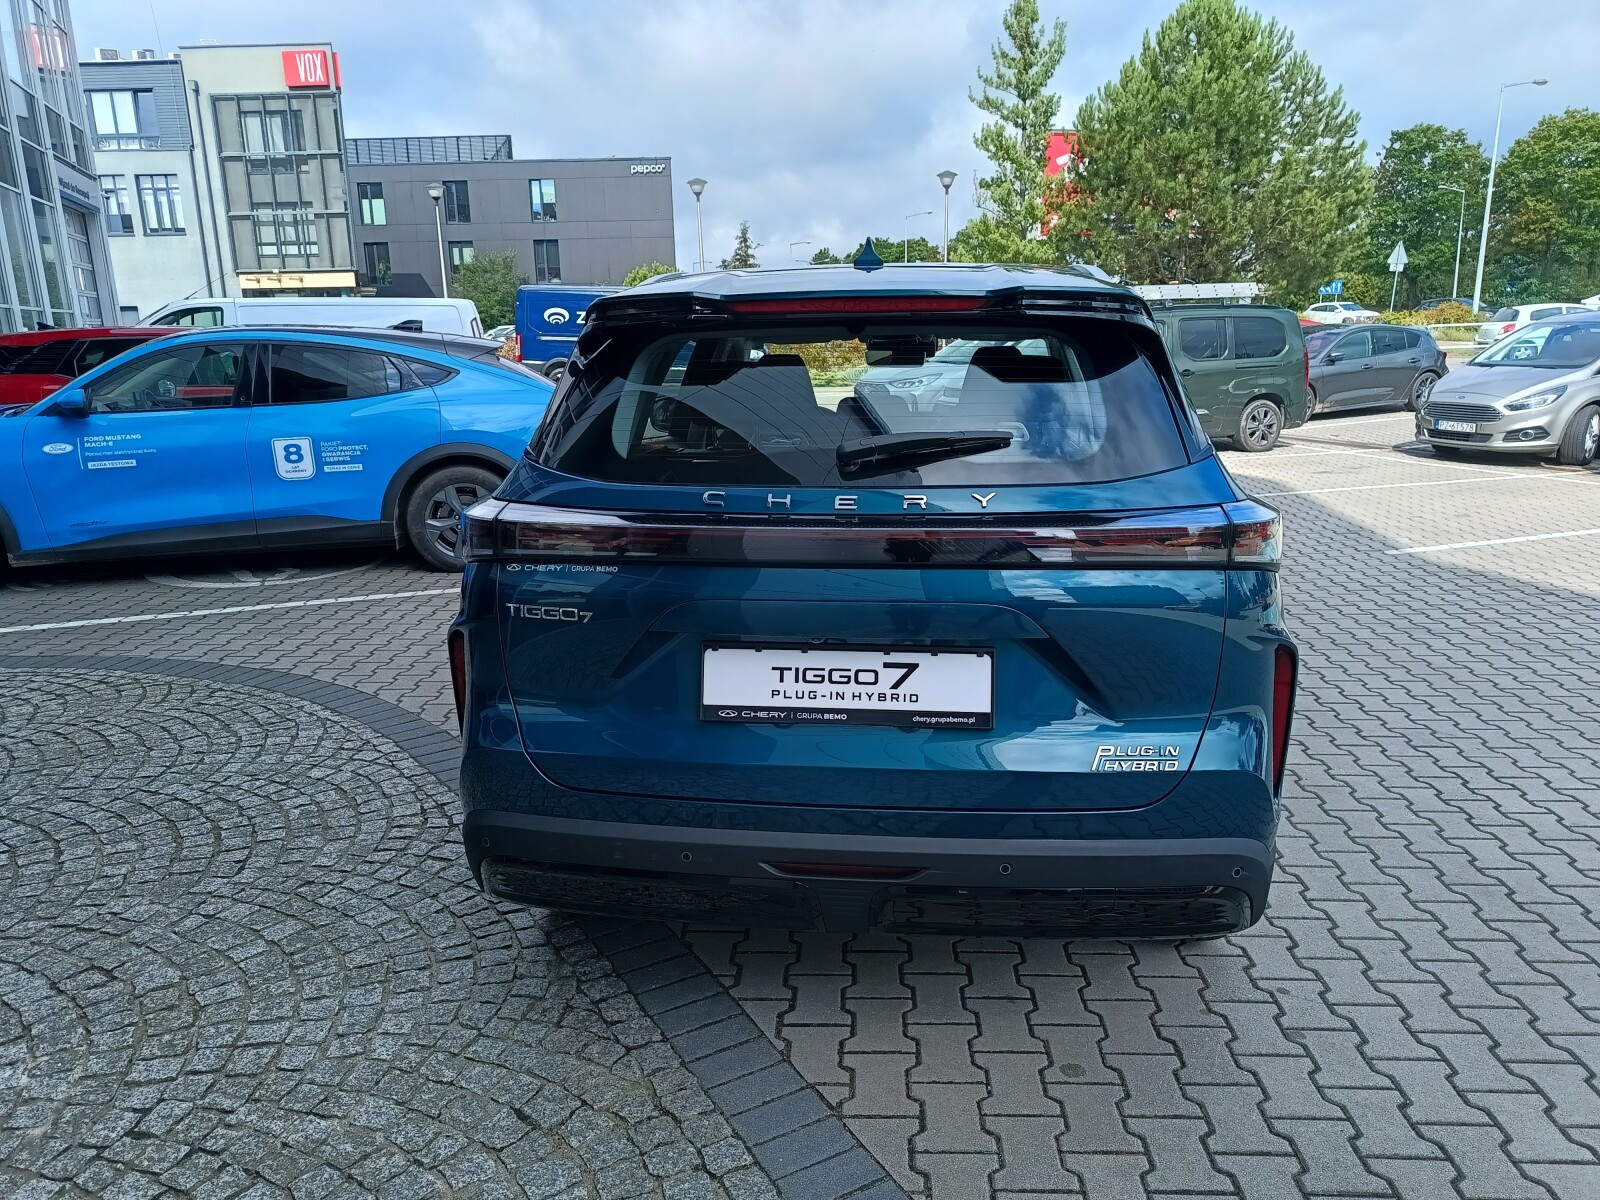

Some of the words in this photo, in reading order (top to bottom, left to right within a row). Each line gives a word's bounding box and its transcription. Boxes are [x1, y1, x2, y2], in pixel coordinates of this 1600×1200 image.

[295, 52, 324, 83] VOX
[630, 164, 663, 175] pepco
[283, 443, 304, 464] 8
[702, 490, 996, 511] CHERY
[524, 564, 563, 572] CHERY
[595, 565, 619, 573] BEMO
[771, 689, 845, 701] PLUG-IN
[851, 692, 919, 703] HYBRID
[741, 710, 787, 719] CHERY
[796, 712, 823, 720] GRUPA
[912, 715, 976, 725] chery.grupabemo.pl
[1091, 745, 1180, 771] PLUG-IN
[1104, 760, 1179, 771] HYBRID
